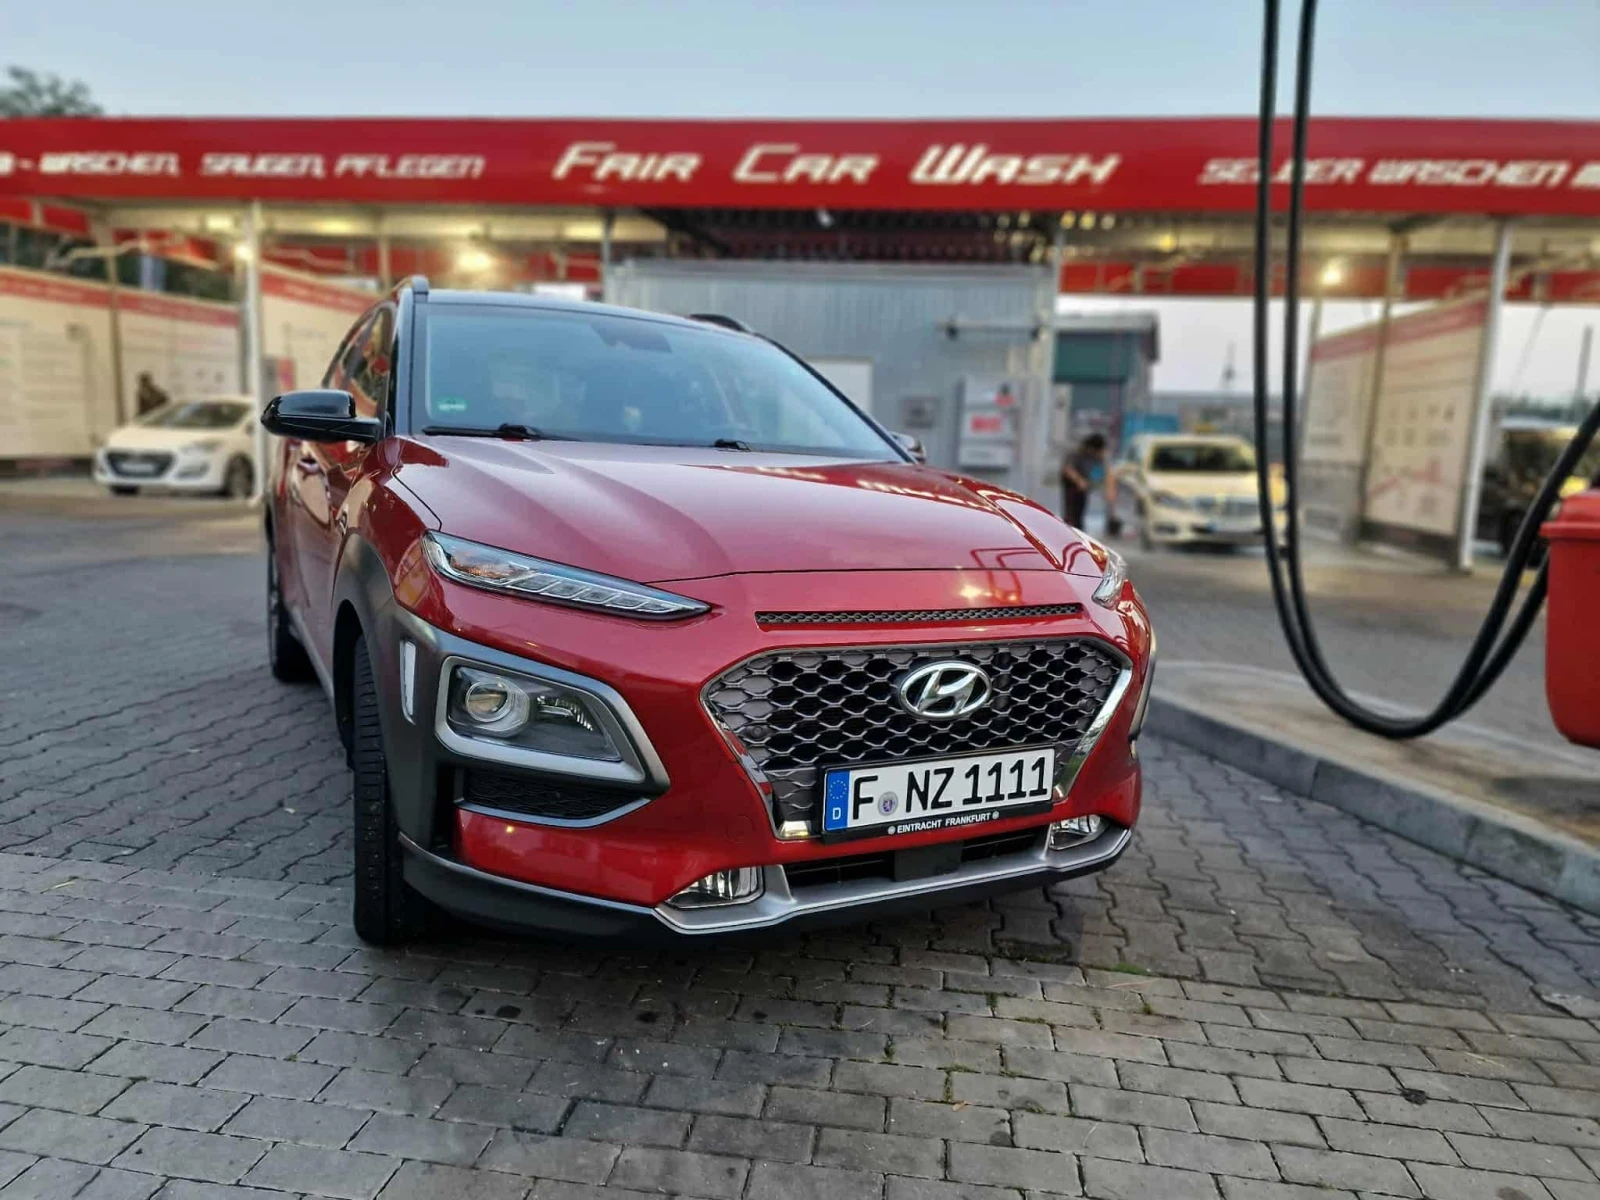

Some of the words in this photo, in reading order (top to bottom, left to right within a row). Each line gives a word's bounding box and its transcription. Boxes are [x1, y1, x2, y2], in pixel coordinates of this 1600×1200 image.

[852, 775, 878, 820] F
[905, 766, 954, 813] NZ
[962, 757, 1048, 805] 1111
[832, 807, 842, 820] D
[897, 819, 942, 834] EINTRACHT
[945, 812, 991, 827] FRANKFURT
